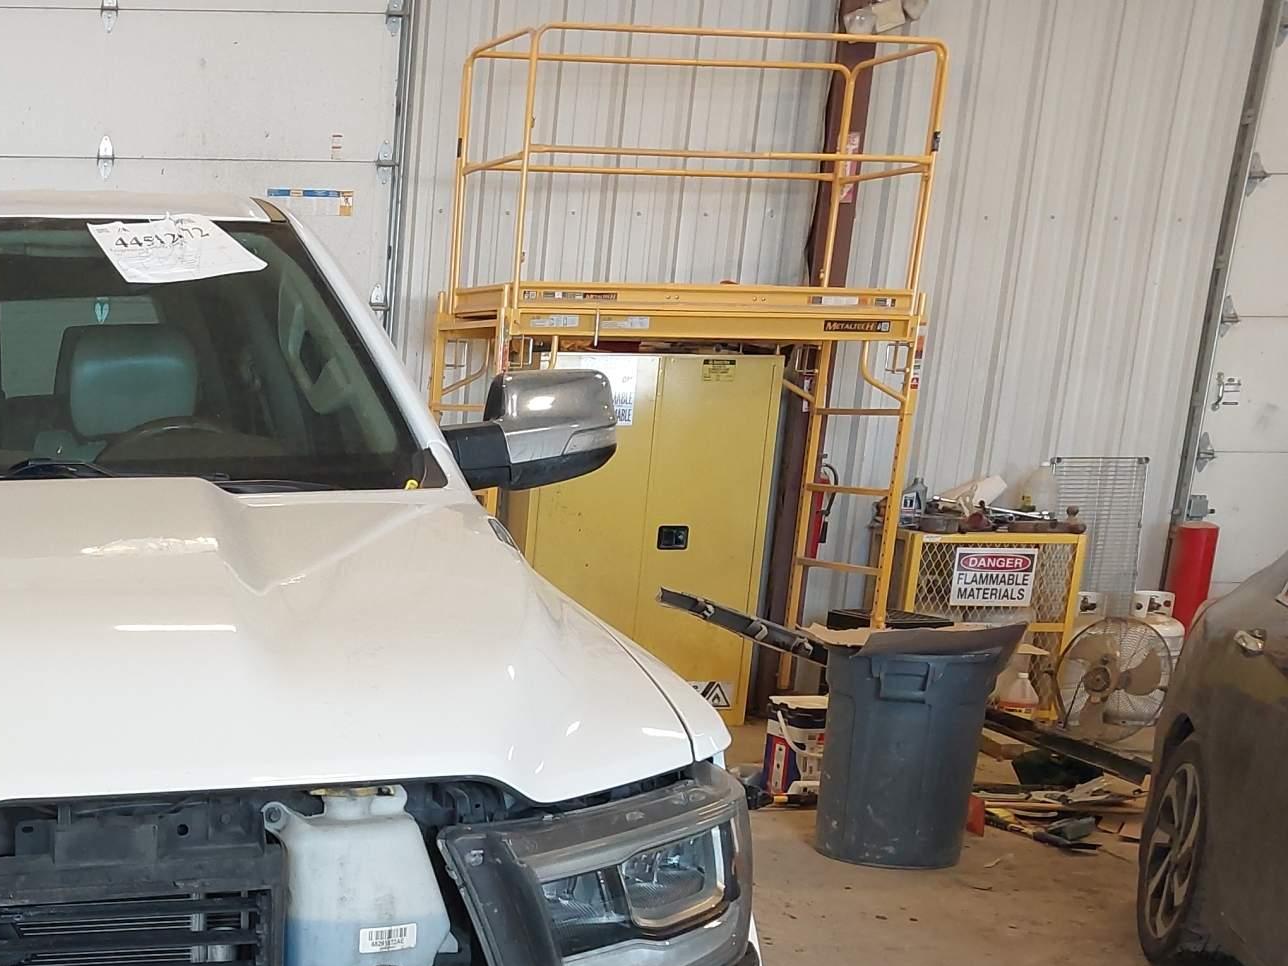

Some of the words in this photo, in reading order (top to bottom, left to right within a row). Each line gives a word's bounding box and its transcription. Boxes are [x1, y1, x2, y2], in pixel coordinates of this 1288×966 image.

[968, 557, 1024, 568] DANGER
[957, 573, 1030, 586] FLAMMABLE
[956, 588, 1025, 601] MATERIALS
